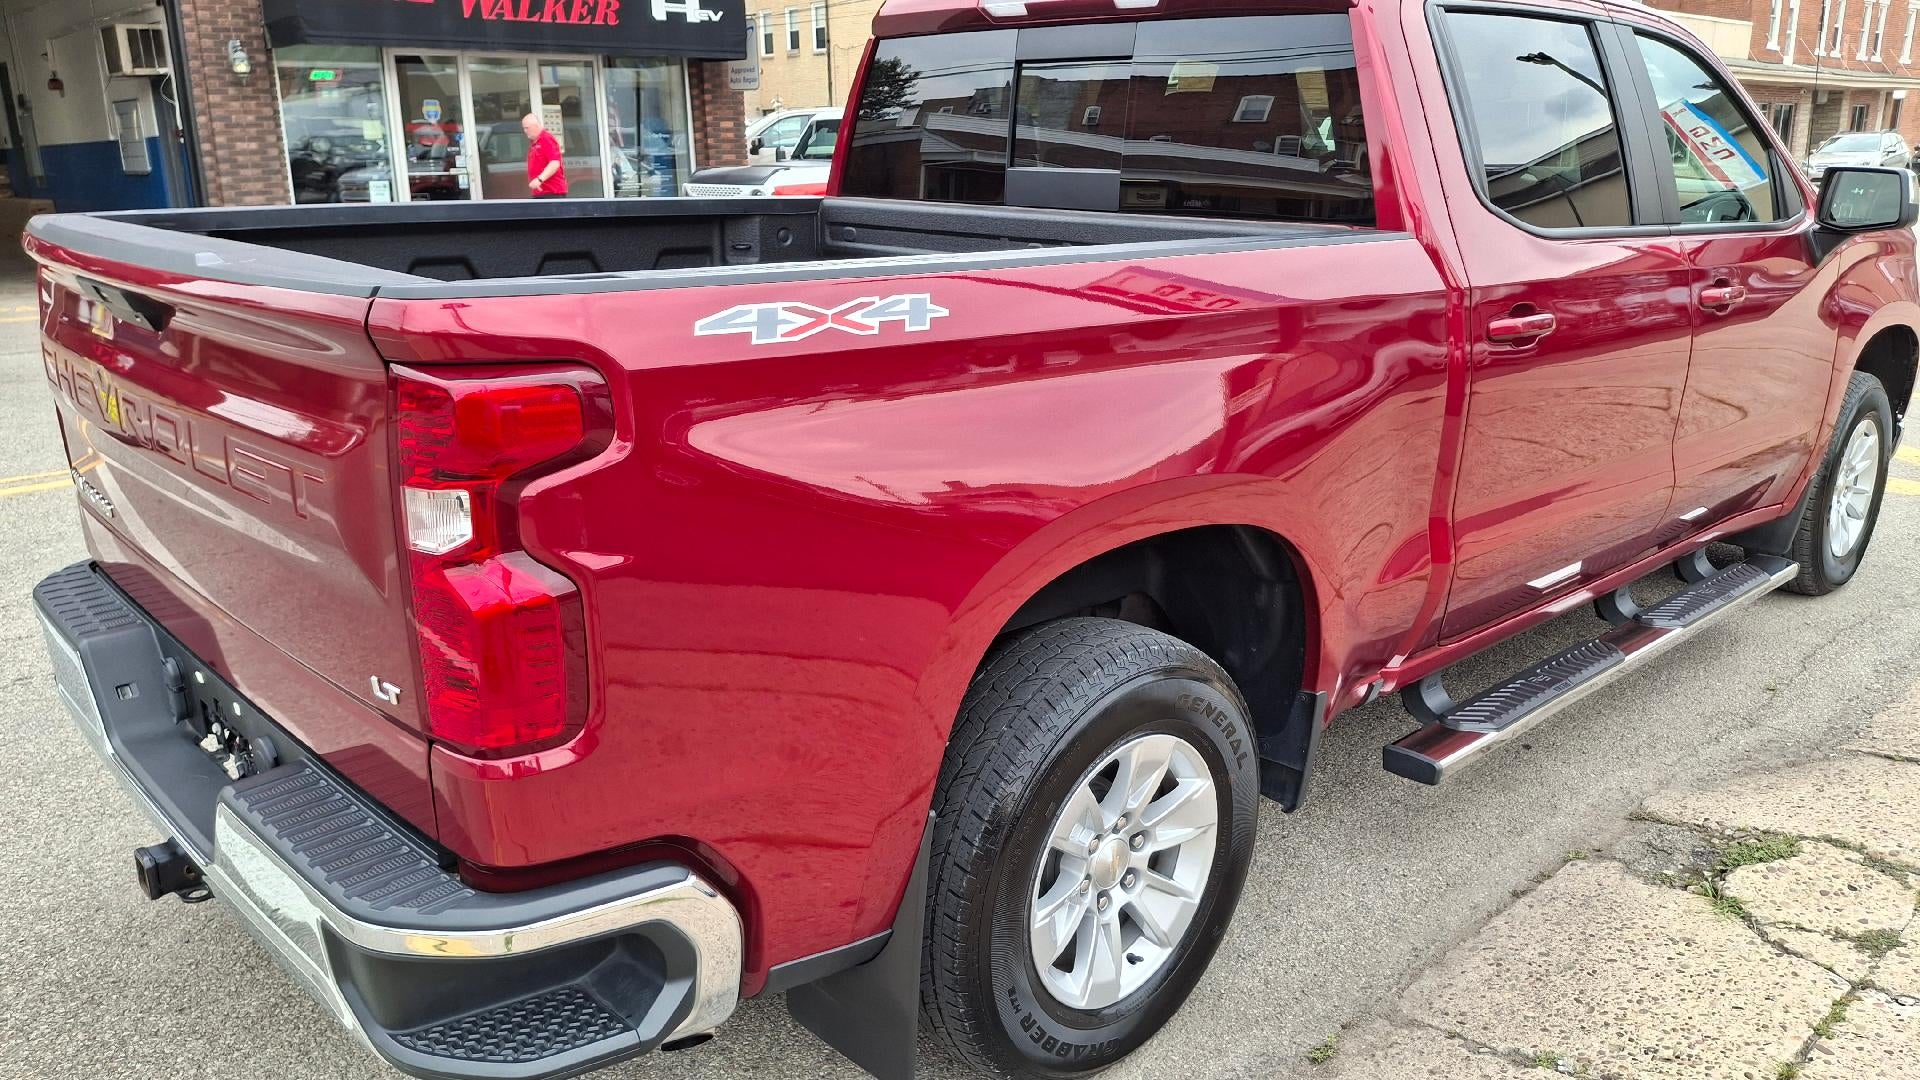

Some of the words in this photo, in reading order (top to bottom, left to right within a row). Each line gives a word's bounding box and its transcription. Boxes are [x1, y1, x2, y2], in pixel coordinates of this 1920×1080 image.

[460, 0, 620, 26] WALKER
[371, 675, 401, 705] LT
[1175, 693, 1248, 771] GENERAL
[1020, 1012, 1120, 1060] GRABBER
